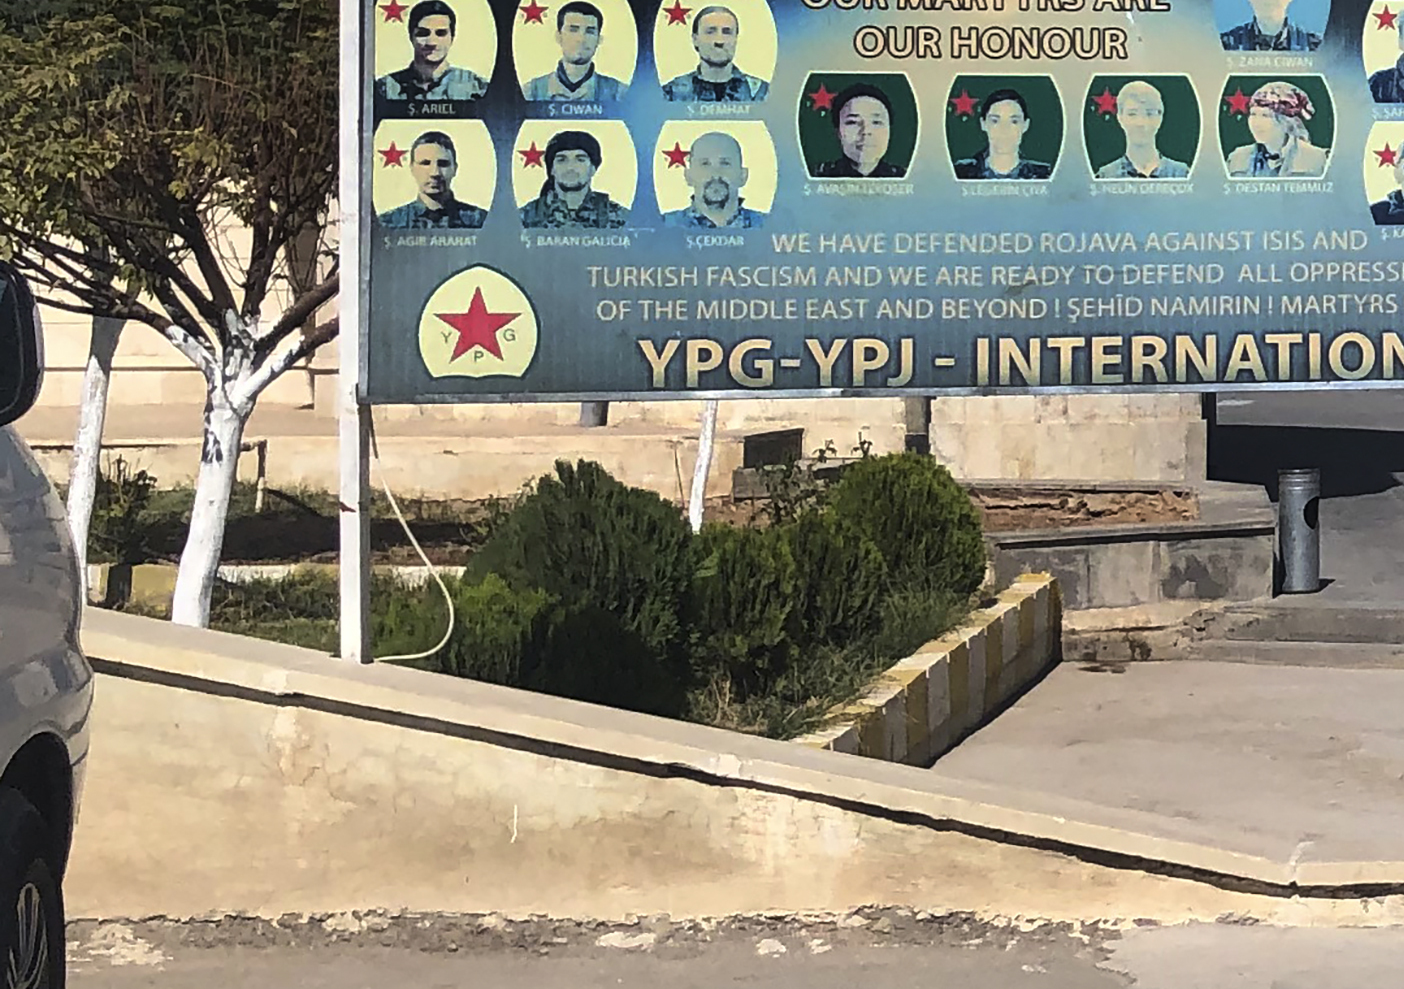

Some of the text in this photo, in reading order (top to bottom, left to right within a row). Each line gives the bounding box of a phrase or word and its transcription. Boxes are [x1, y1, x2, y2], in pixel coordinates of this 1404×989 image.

[853, 25, 1128, 60] OUR HONOUR
[421, 103, 456, 114] ARIEL
[772, 229, 1368, 254] WE HAVE DEFENDED ROJAVA AGAINST ISIS AND
[587, 266, 698, 287] TURKISH
[706, 265, 817, 288] FASCISM
[824, 265, 882, 287] AND
[888, 265, 927, 286] WE
[934, 265, 984, 286] ARE
[990, 264, 1075, 286] READY
[1083, 264, 1115, 285] TO
[1122, 263, 1224, 285] DEFEND
[1238, 262, 1282, 284] ALL
[596, 300, 631, 321] OF
[638, 299, 688, 320] THE
[696, 298, 797, 320] MIDDLE
[806, 298, 868, 320] EAST
[875, 298, 934, 319] AND
[941, 297, 1047, 319] BEYOND
[1150, 294, 1260, 316] NAMIRIN
[1281, 293, 1399, 315] MARTYRS
[637, 337, 915, 389] YPG-YPJ
